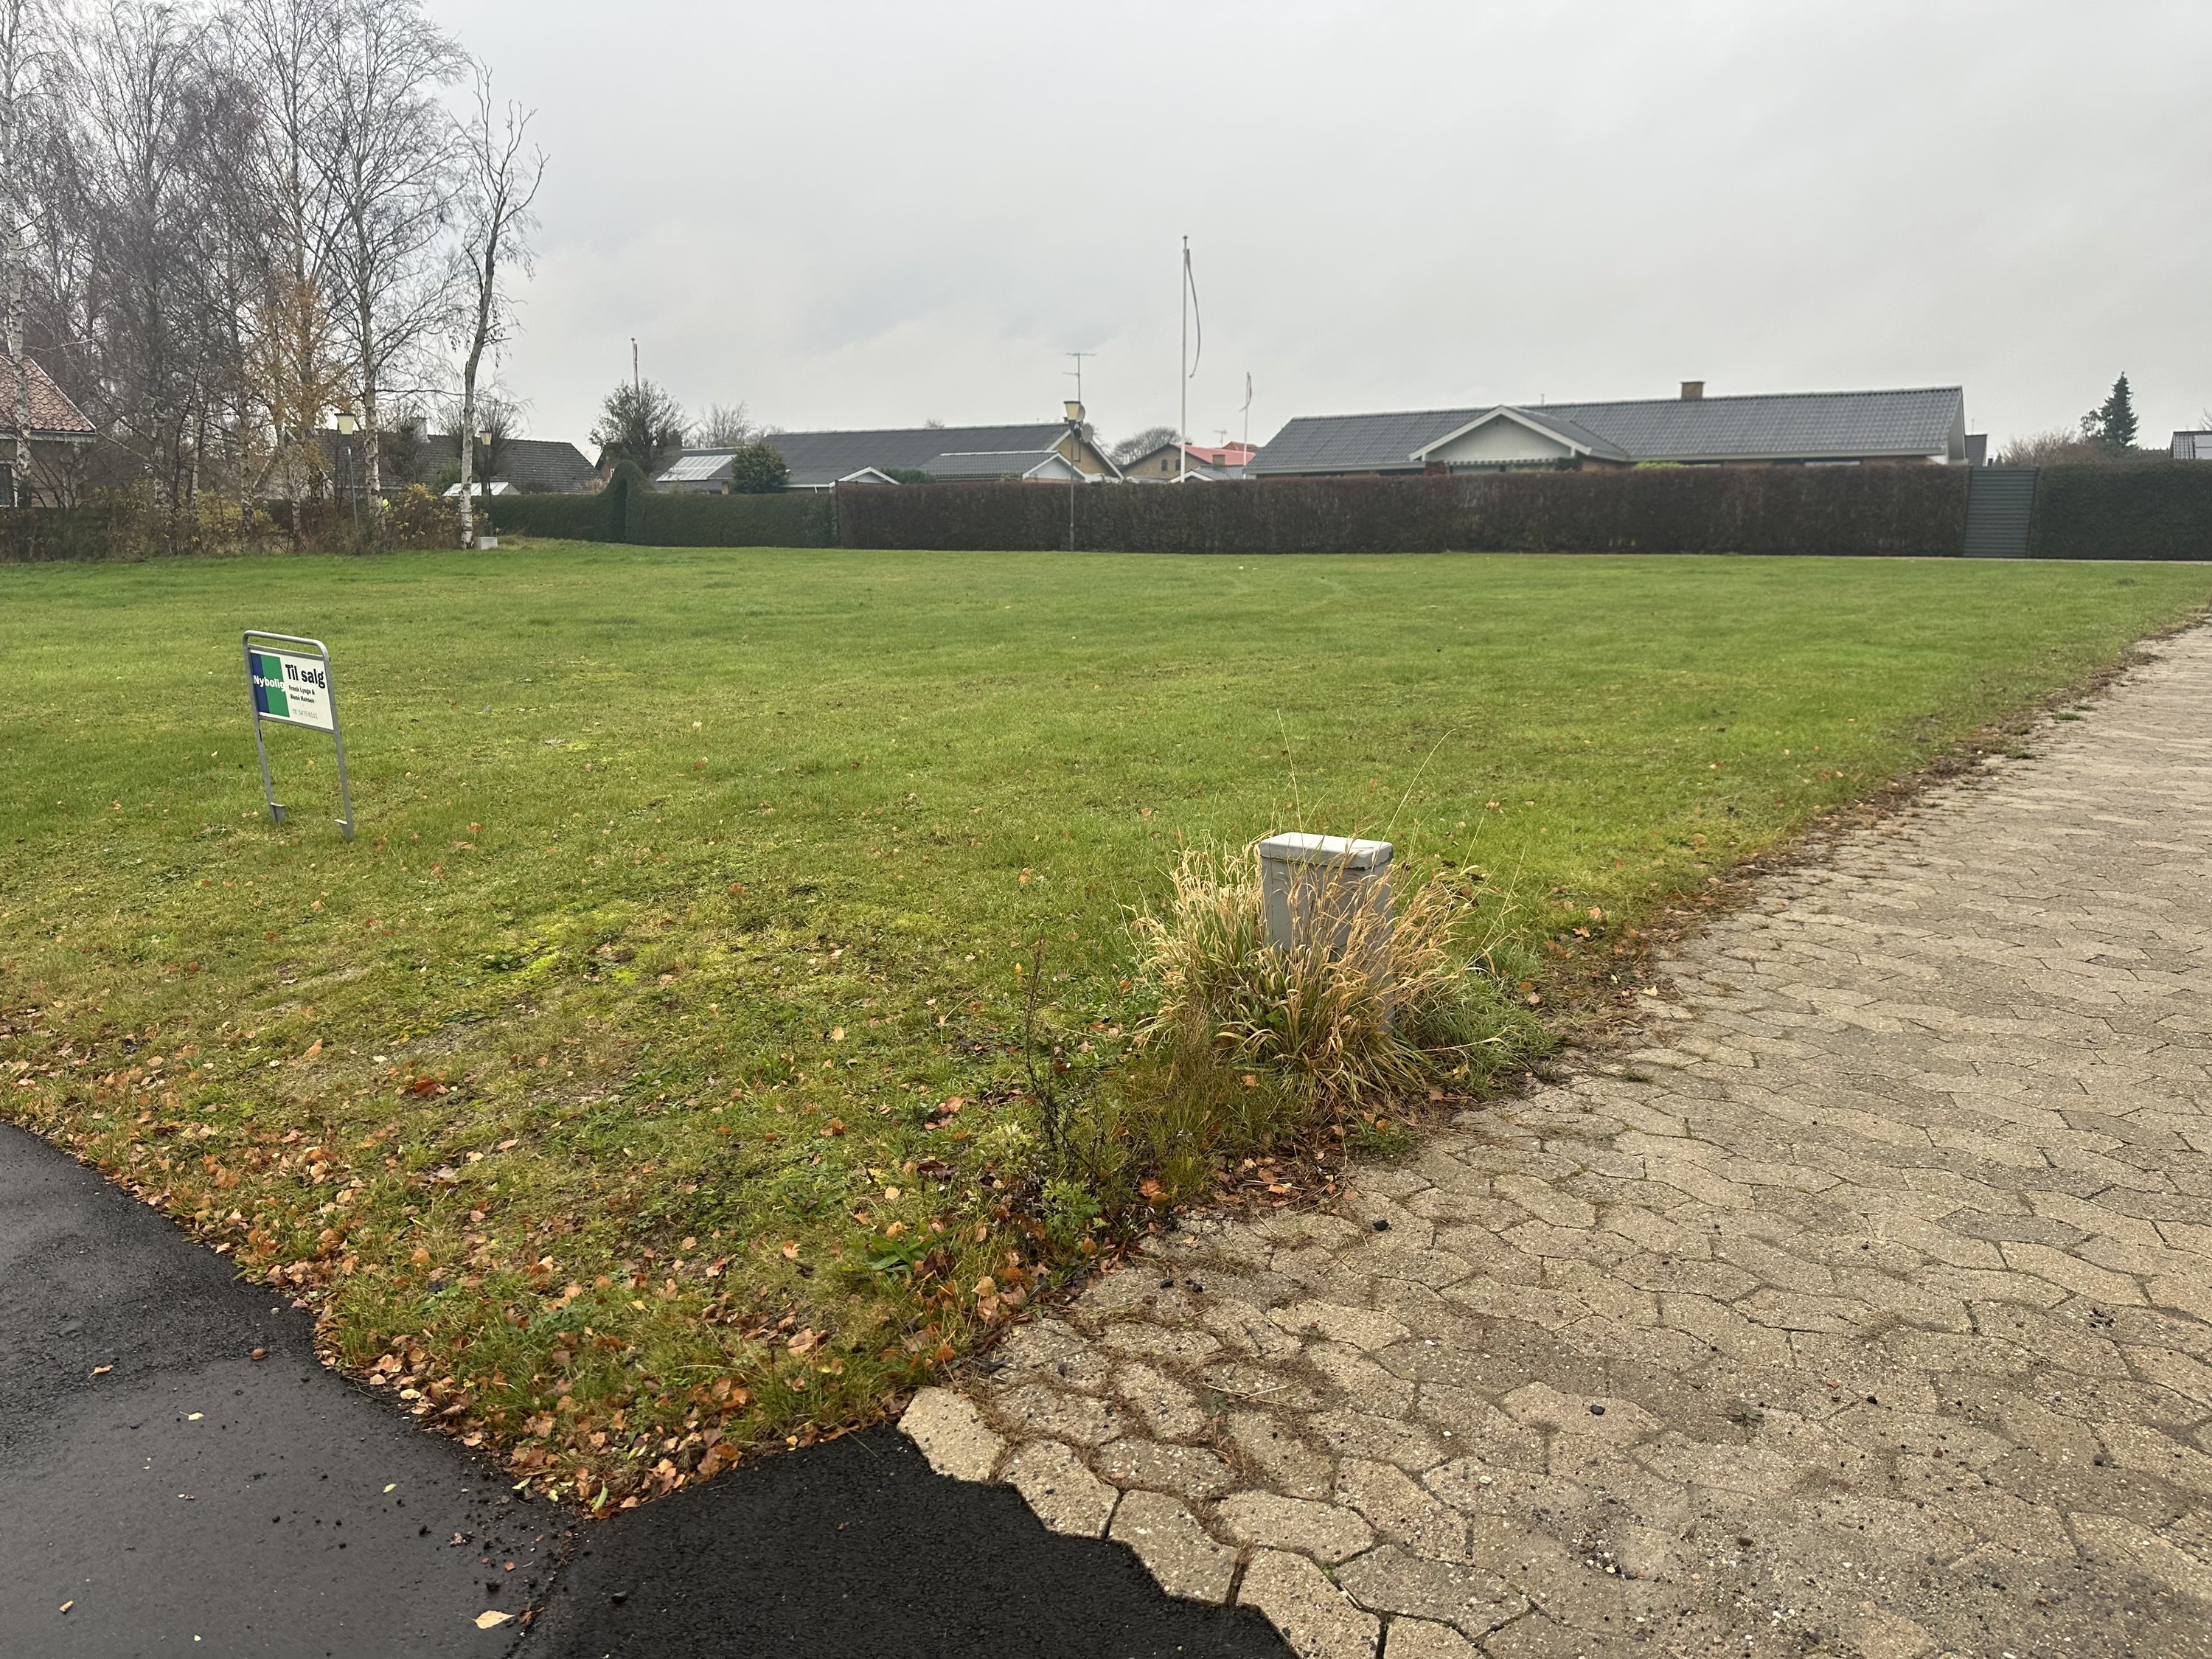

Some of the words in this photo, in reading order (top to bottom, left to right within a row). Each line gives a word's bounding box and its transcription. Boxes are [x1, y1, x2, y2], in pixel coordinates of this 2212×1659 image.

[253, 675, 285, 692] Nybolig
[285, 664, 299, 681] Til
[301, 669, 325, 689] salg
